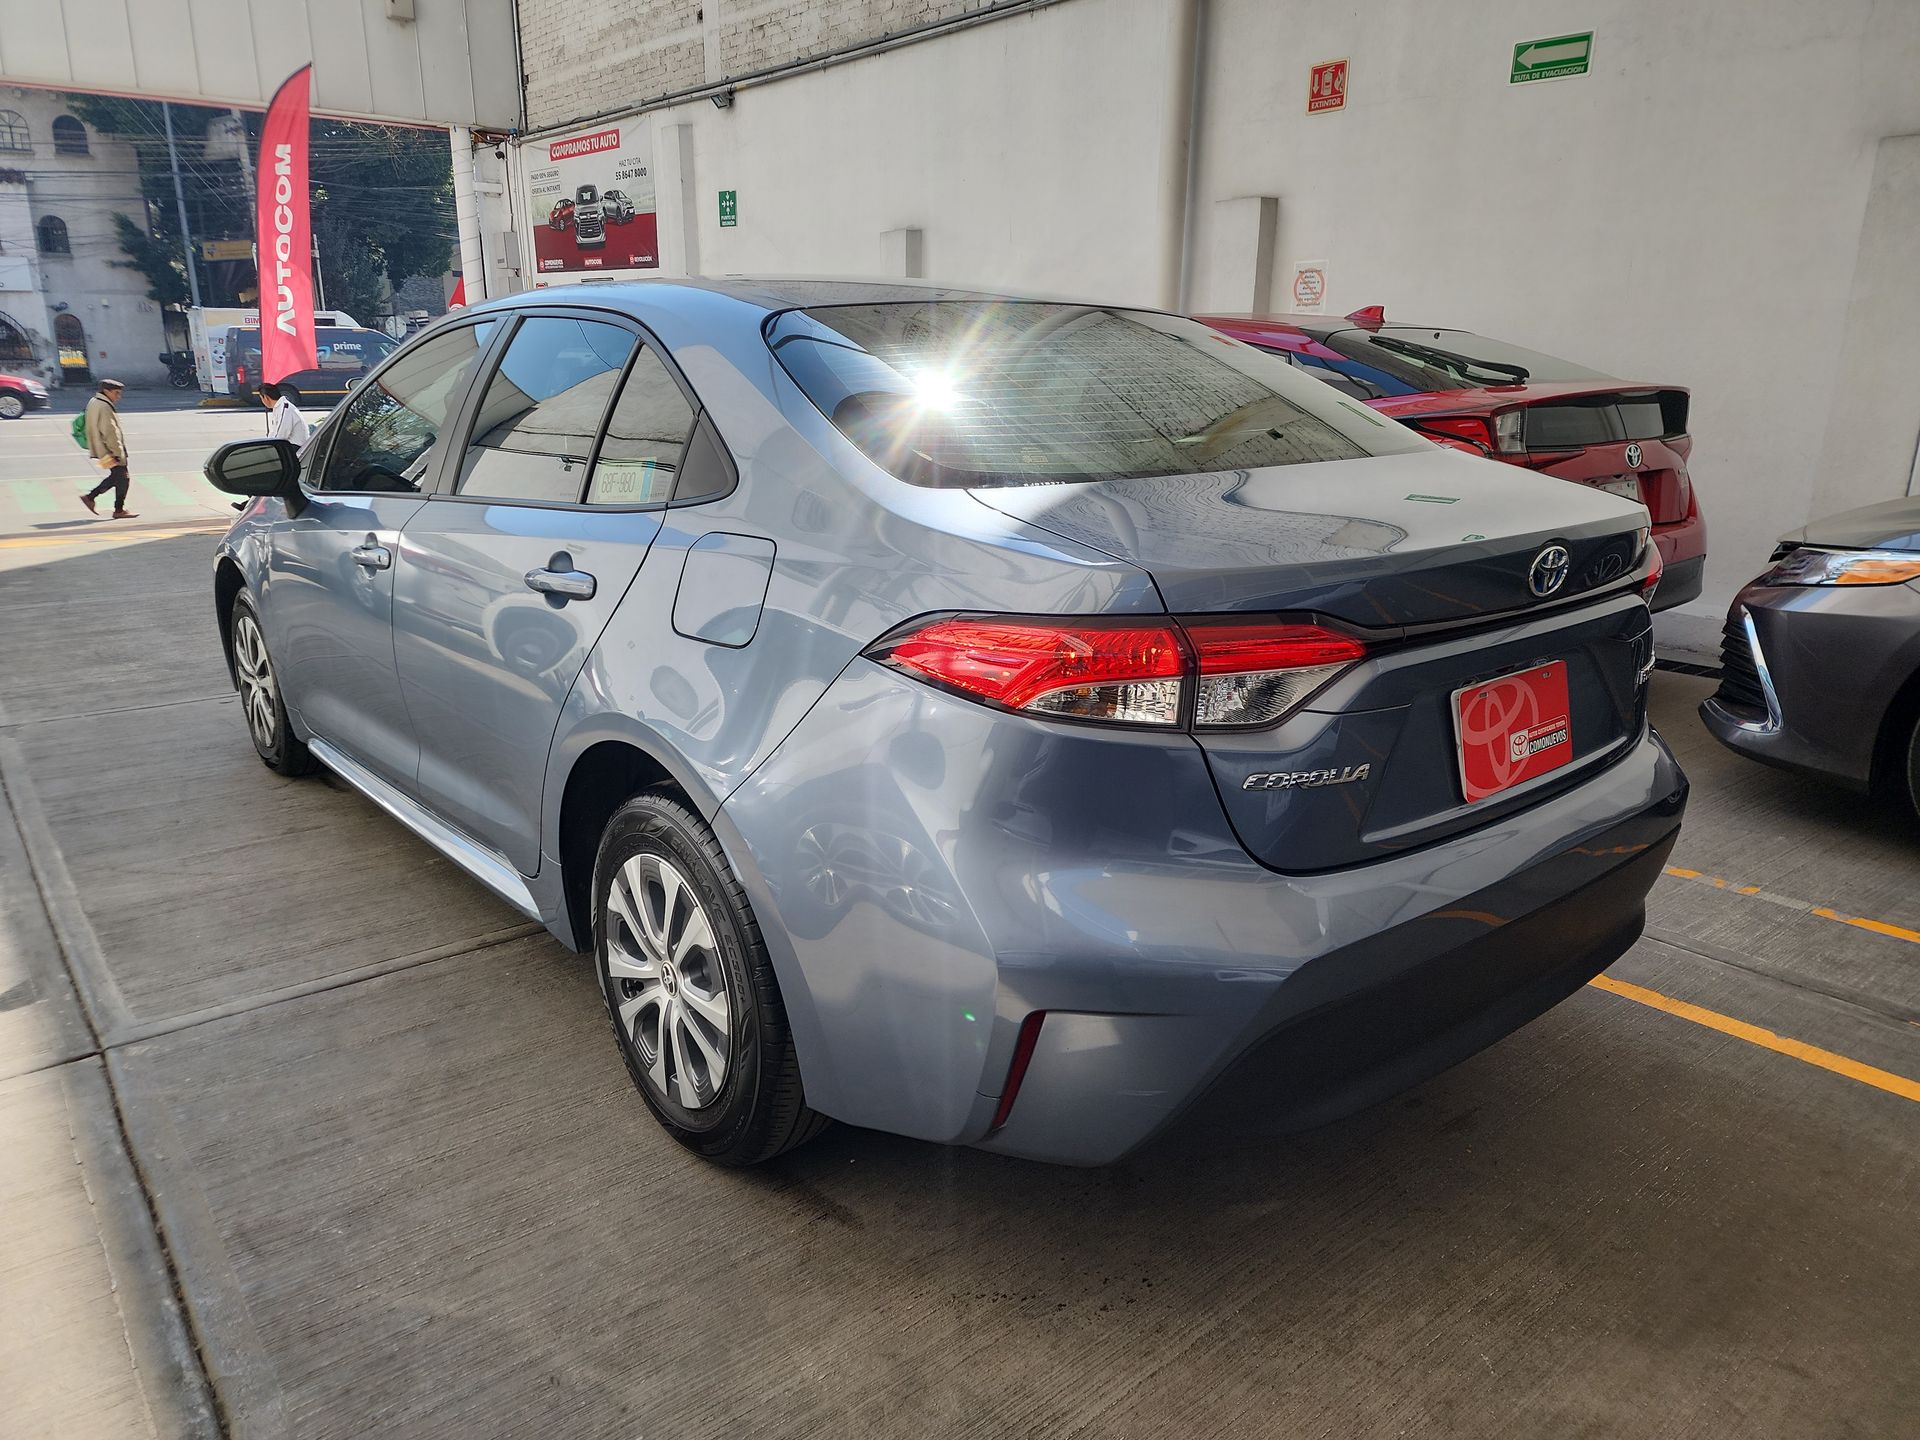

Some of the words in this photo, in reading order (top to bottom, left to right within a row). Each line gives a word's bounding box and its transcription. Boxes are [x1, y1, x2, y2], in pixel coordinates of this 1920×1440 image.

[1513, 74, 1531, 82] RUTA
[1531, 71, 1541, 79] DE
[1311, 98, 1342, 109] EXTINTOR
[551, 140, 591, 158] COMPRAMOS
[590, 137, 600, 150] TU
[600, 133, 618, 148] AUTO
[618, 159, 627, 167] HAZ
[615, 171, 622, 180] 55
[622, 169, 634, 179] 8647
[634, 167, 648, 178] 8000
[274, 144, 296, 336] AUTOCOM
[333, 341, 362, 351] prime
[1530, 729, 1567, 752] COMONUEVOS
[1242, 763, 1371, 791] COROLLA
